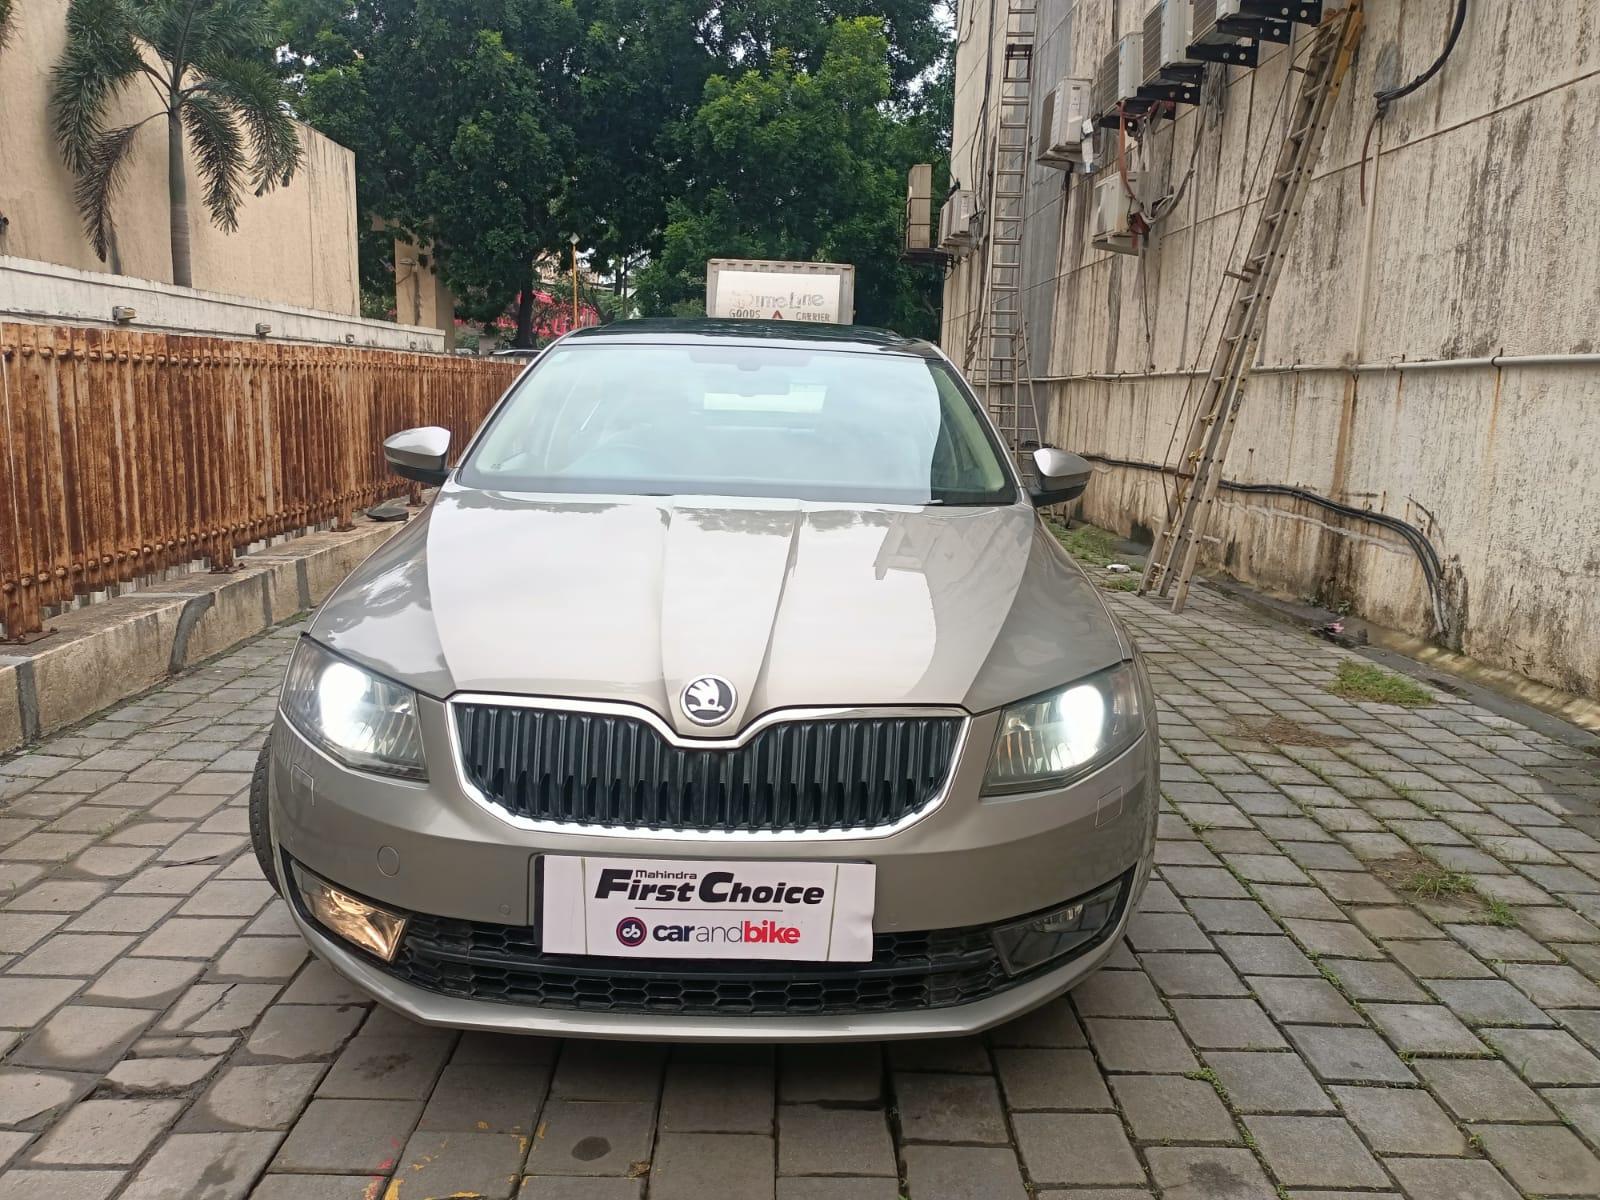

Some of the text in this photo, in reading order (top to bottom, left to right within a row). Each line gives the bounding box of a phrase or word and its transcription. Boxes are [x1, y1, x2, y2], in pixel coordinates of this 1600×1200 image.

[729, 309, 831, 322] GOODS CARRIER
[635, 869, 698, 880] Mahindra
[594, 868, 825, 905] First Choice
[652, 920, 801, 944] carandbike
